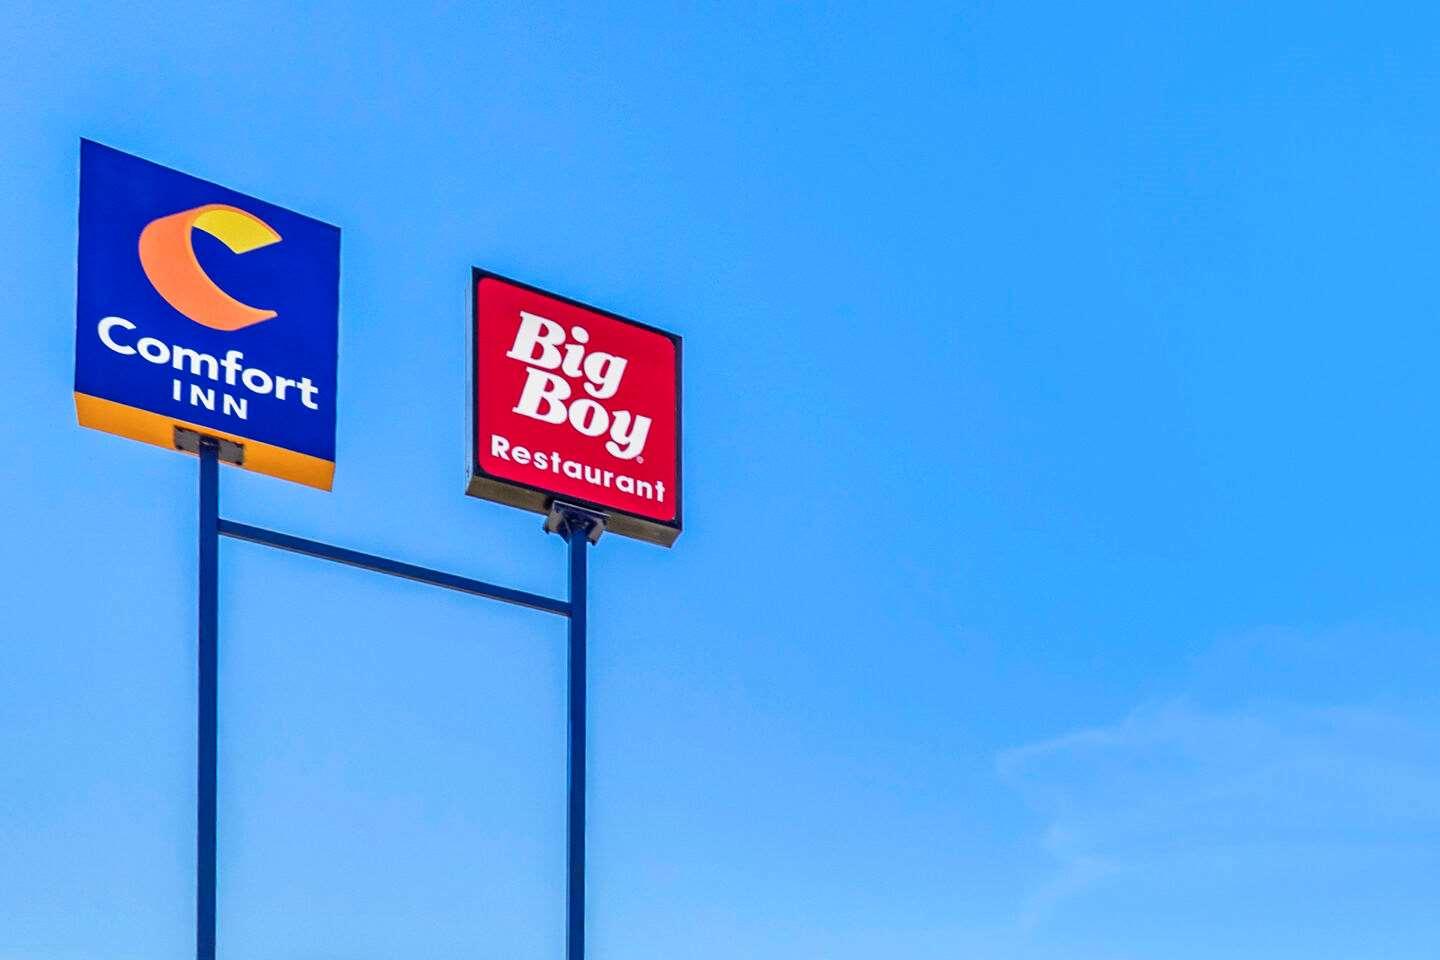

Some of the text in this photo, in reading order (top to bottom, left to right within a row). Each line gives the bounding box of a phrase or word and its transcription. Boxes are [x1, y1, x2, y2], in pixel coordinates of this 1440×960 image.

[97, 316, 319, 410] Comfort
[506, 310, 628, 399] Big
[172, 379, 248, 420] INN
[511, 366, 652, 460] Boy
[491, 434, 666, 503] Restaurant
